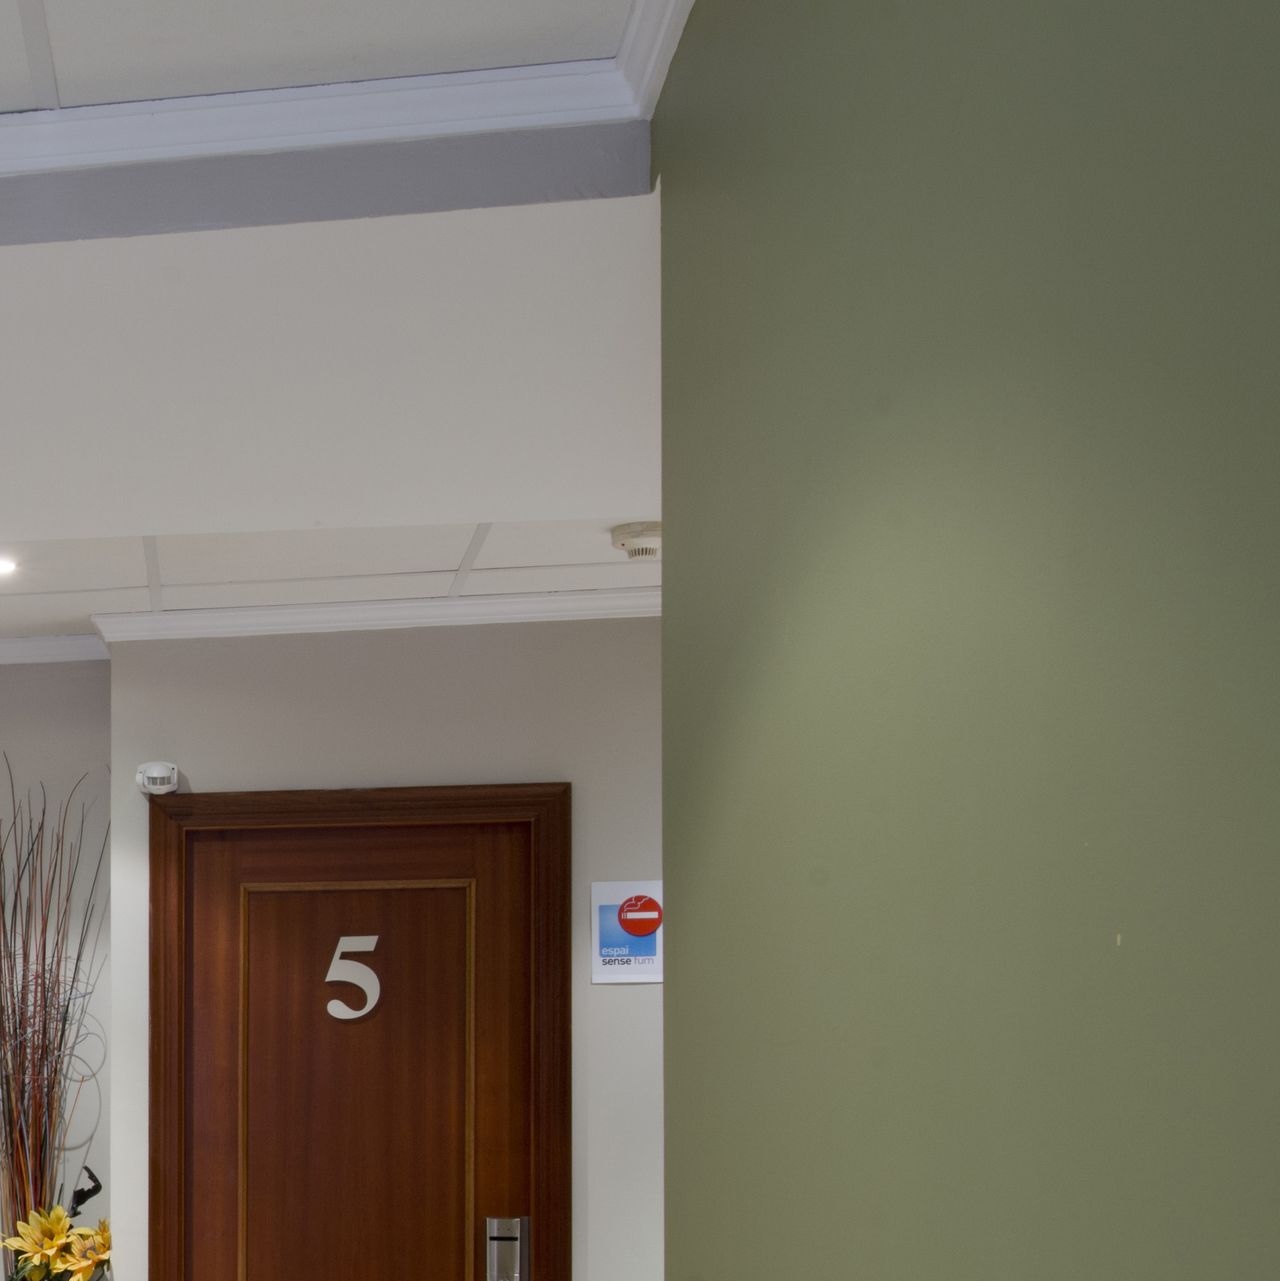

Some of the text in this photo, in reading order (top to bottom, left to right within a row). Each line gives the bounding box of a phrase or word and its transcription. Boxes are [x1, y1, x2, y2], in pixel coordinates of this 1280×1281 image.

[602, 945, 629, 957] espai
[602, 957, 654, 966] sense fum
[324, 935, 380, 1019] 5
